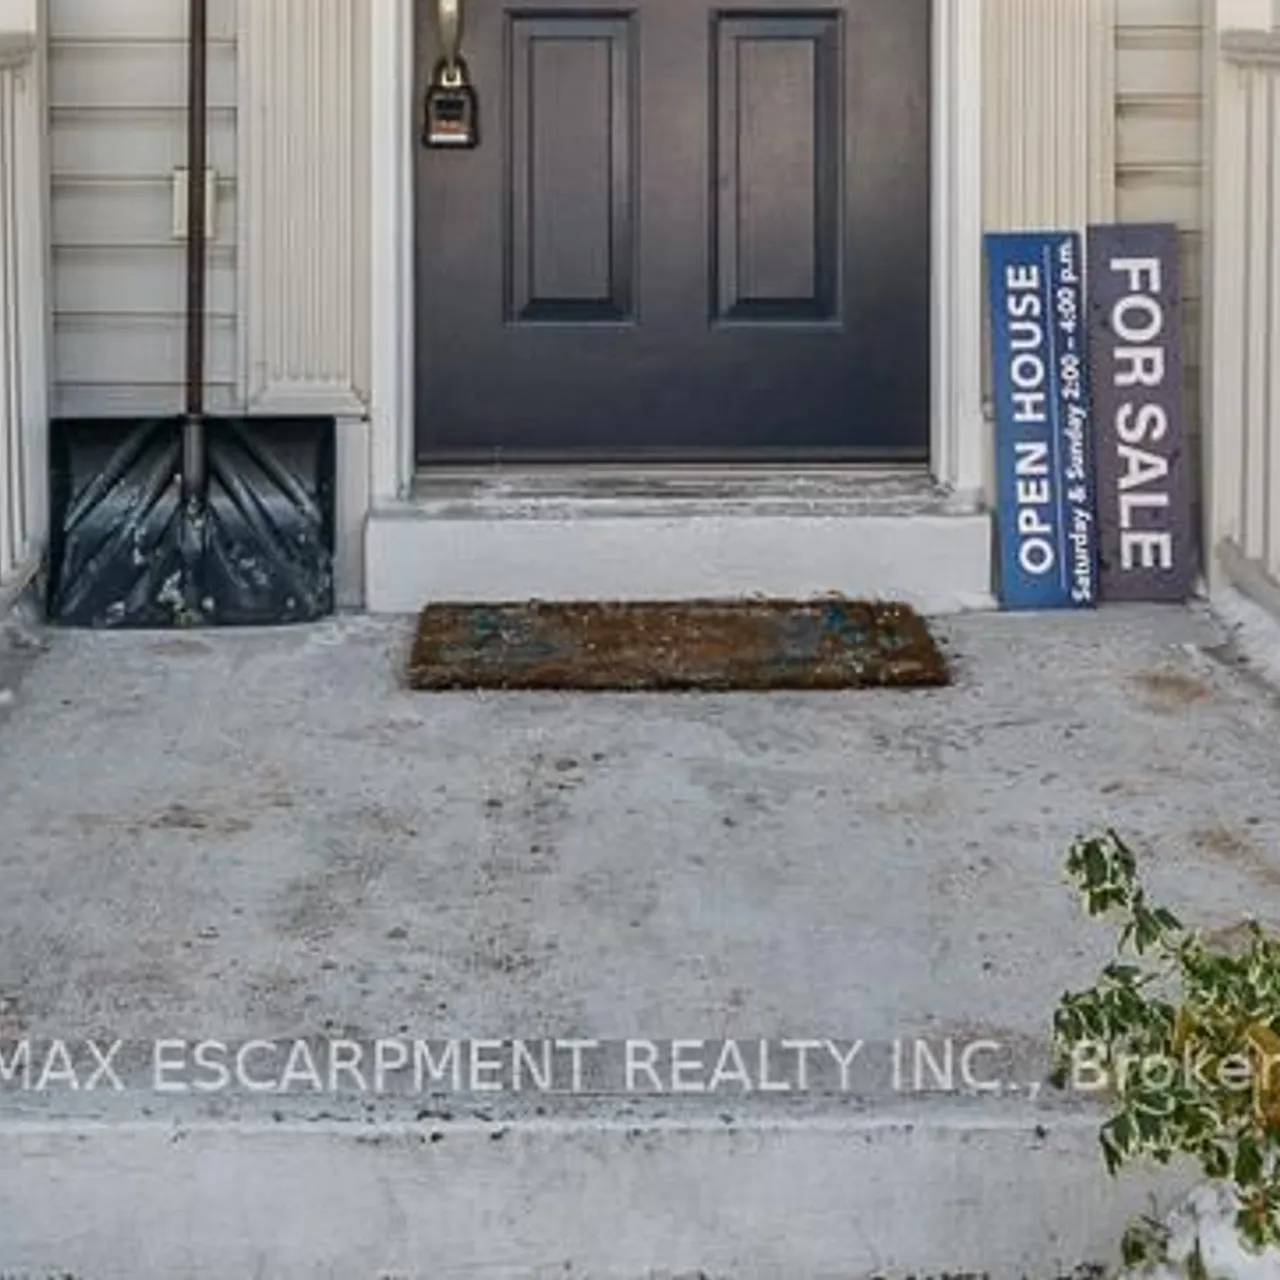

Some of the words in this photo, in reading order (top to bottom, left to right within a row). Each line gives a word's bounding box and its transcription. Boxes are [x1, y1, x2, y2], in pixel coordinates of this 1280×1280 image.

[1059, 239, 1078, 282] p.m.
[1007, 263, 1045, 423] HOUSE
[1057, 287, 1076, 333] 4:00
[1110, 257, 1165, 387] FOR
[1060, 353, 1080, 399] 2:00
[1064, 403, 1087, 478] Sunday
[1017, 440, 1054, 574] OPEN
[1068, 484, 1088, 503] &
[1116, 403, 1172, 570] SALE
[1069, 508, 1093, 602] Saturday
